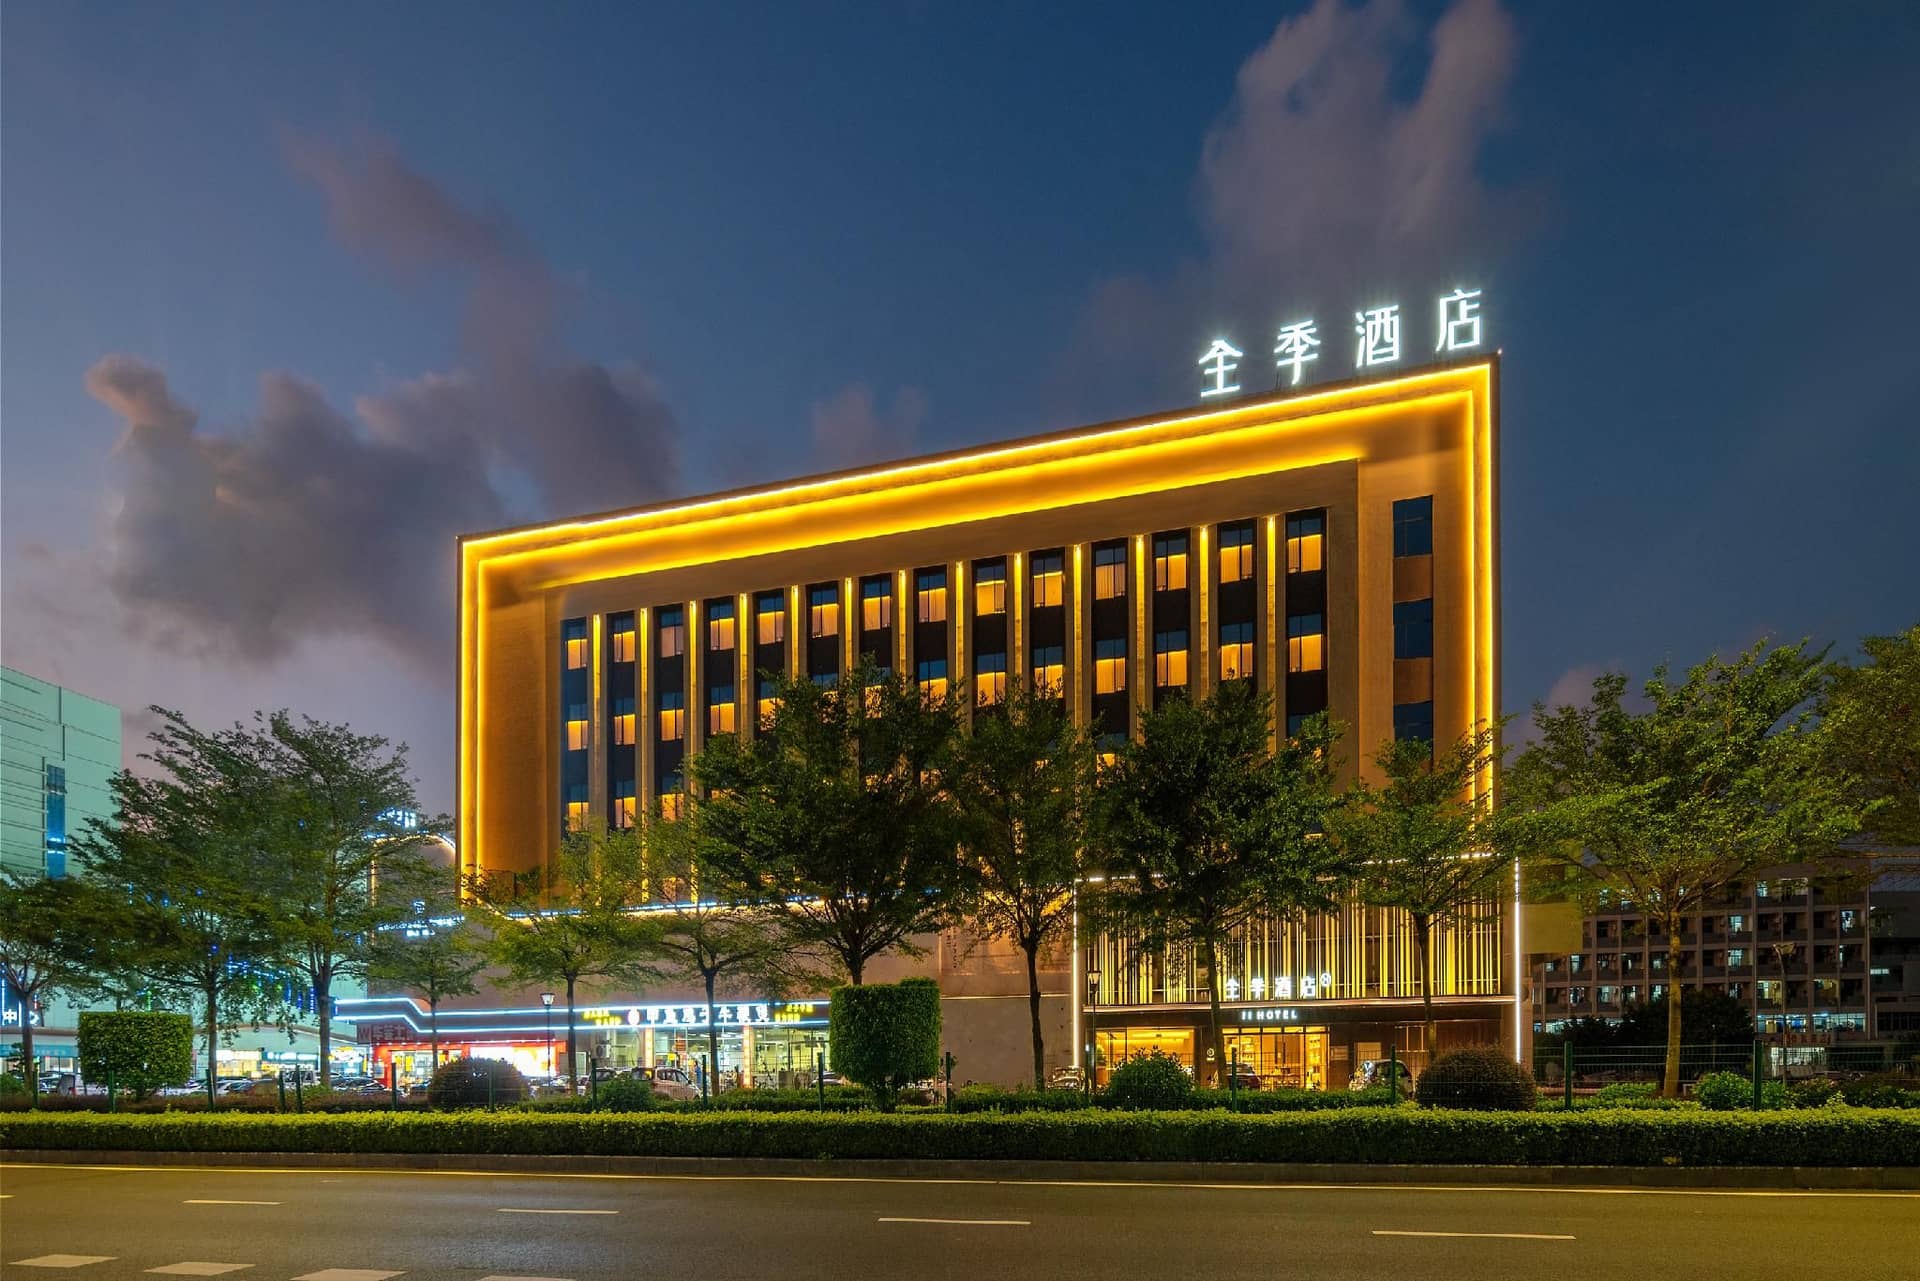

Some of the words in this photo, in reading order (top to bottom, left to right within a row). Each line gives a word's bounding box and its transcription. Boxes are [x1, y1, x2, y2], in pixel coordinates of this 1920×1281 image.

[1198, 288, 1482, 398] 全季酒店
[1226, 975, 1316, 1001] 全季酒店
[1256, 1009, 1298, 1020] HOTEL
